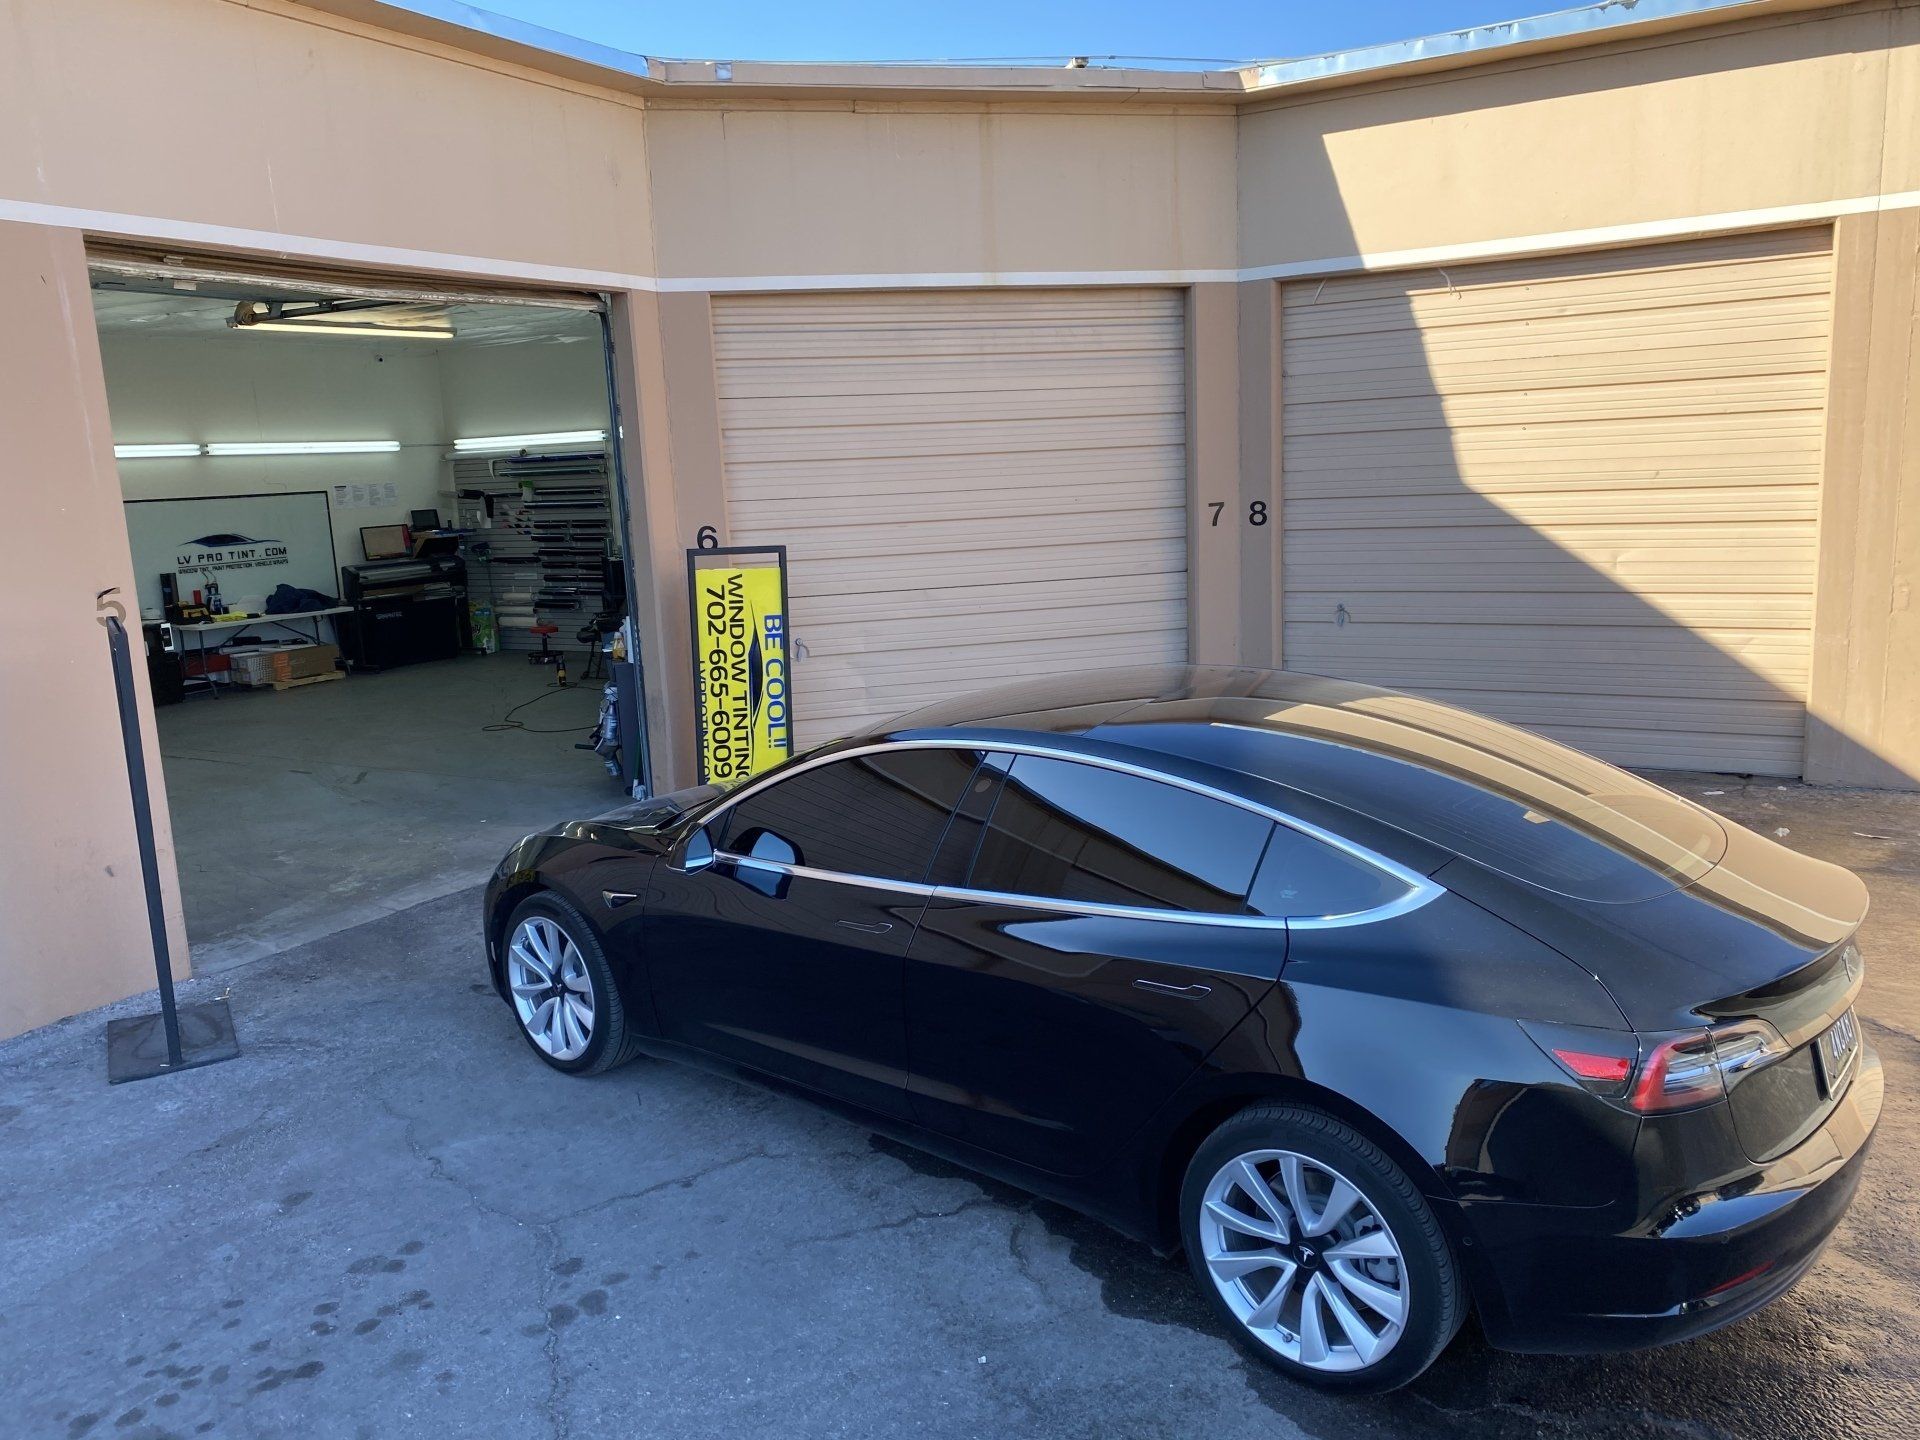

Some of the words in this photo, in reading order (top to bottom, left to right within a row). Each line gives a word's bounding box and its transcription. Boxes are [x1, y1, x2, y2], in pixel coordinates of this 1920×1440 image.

[1208, 502, 1224, 526] 7
[1249, 500, 1267, 526] 8
[696, 525, 718, 549] 6
[177, 555, 191, 565] LV
[198, 552, 223, 563] PRO
[96, 587, 126, 627] 5
[727, 574, 747, 684] WINDOW
[764, 614, 783, 650] BE
[706, 585, 732, 779] 702-665-6009
[765, 658, 787, 749] COOL!!
